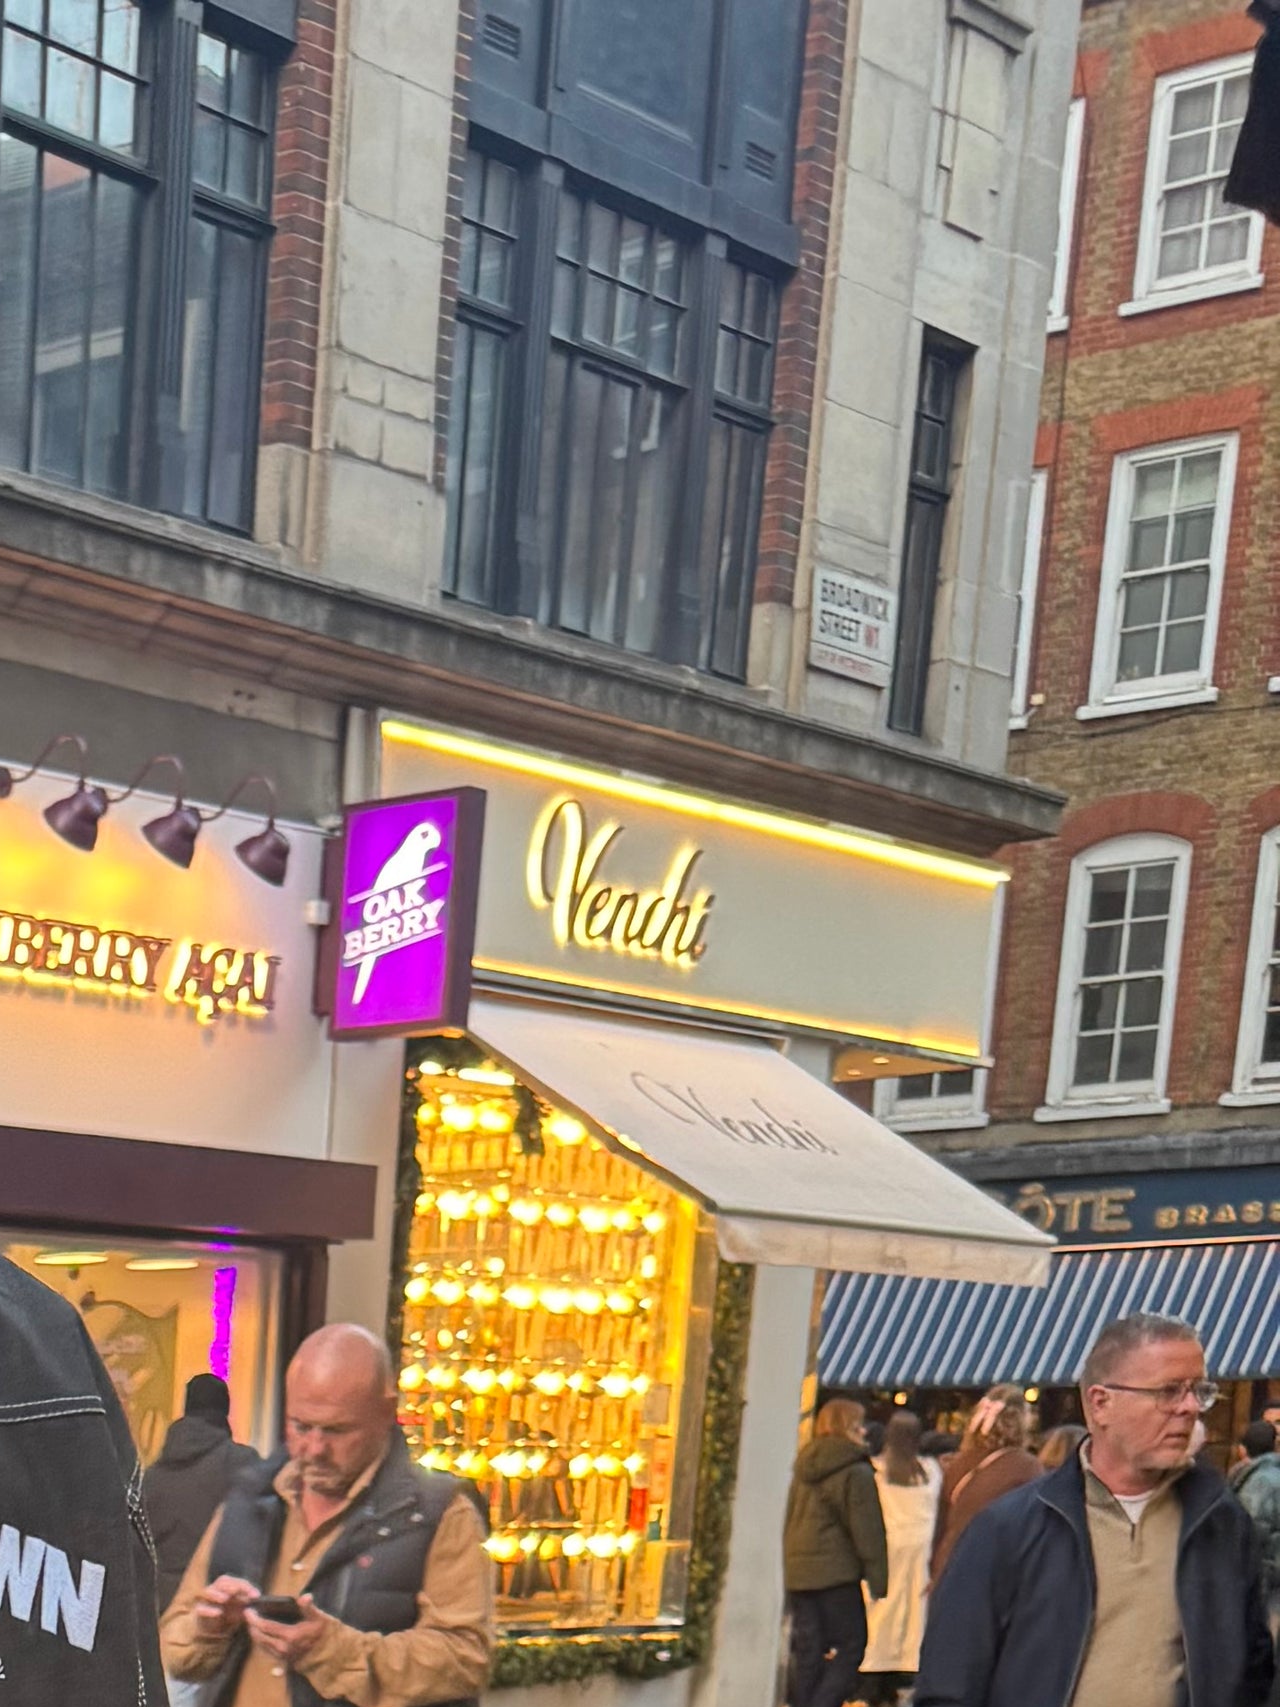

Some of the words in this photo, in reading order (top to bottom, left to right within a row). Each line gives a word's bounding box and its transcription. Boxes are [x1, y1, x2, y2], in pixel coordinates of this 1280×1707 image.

[819, 608, 861, 642] STREET
[362, 879, 426, 923] OAK
[527, 796, 716, 966] Venchi
[342, 898, 445, 960] BERRY
[993, 1181, 1136, 1233] ÔTE
